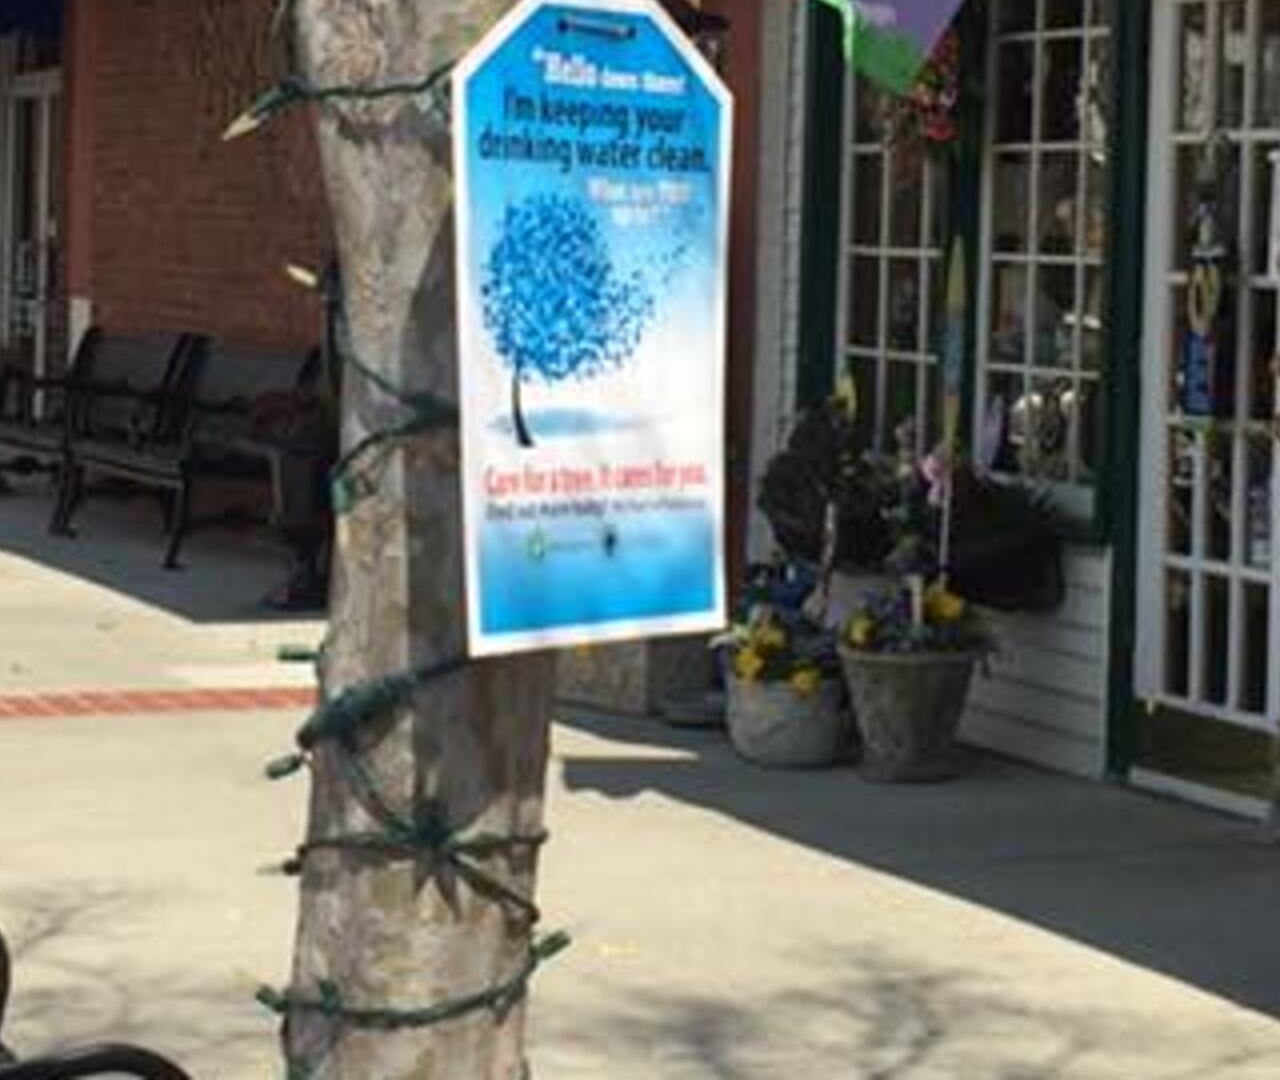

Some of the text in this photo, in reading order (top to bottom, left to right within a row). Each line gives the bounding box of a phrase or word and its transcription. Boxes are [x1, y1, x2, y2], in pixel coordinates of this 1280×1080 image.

[539, 91, 632, 140] keeping
[634, 104, 687, 138] your
[478, 122, 572, 174] drinking
[576, 134, 642, 168] water
